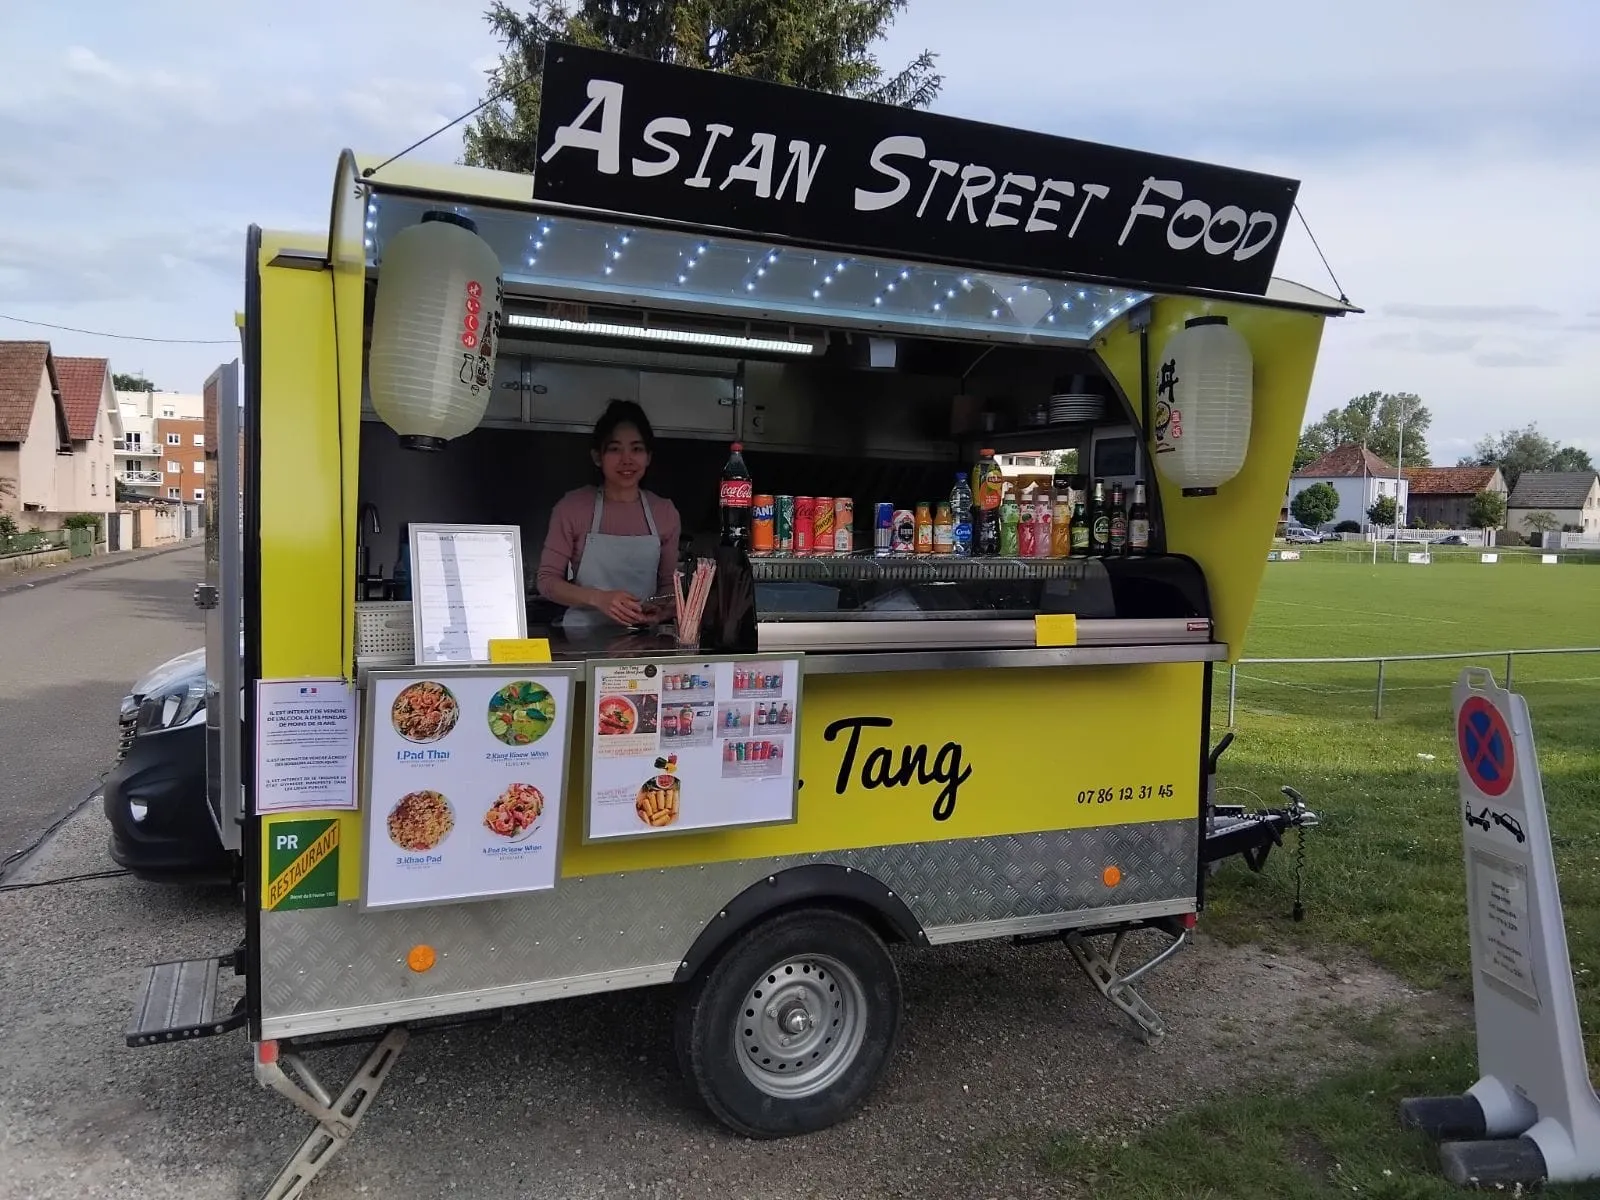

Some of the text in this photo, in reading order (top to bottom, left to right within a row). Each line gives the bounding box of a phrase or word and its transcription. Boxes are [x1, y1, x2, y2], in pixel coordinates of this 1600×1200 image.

[823, 716, 973, 821] Tang
[1077, 784, 1174, 805] 07 86 12 31 45
[270, 826, 337, 904] RESTAURANT
[276, 834, 299, 850] PR
